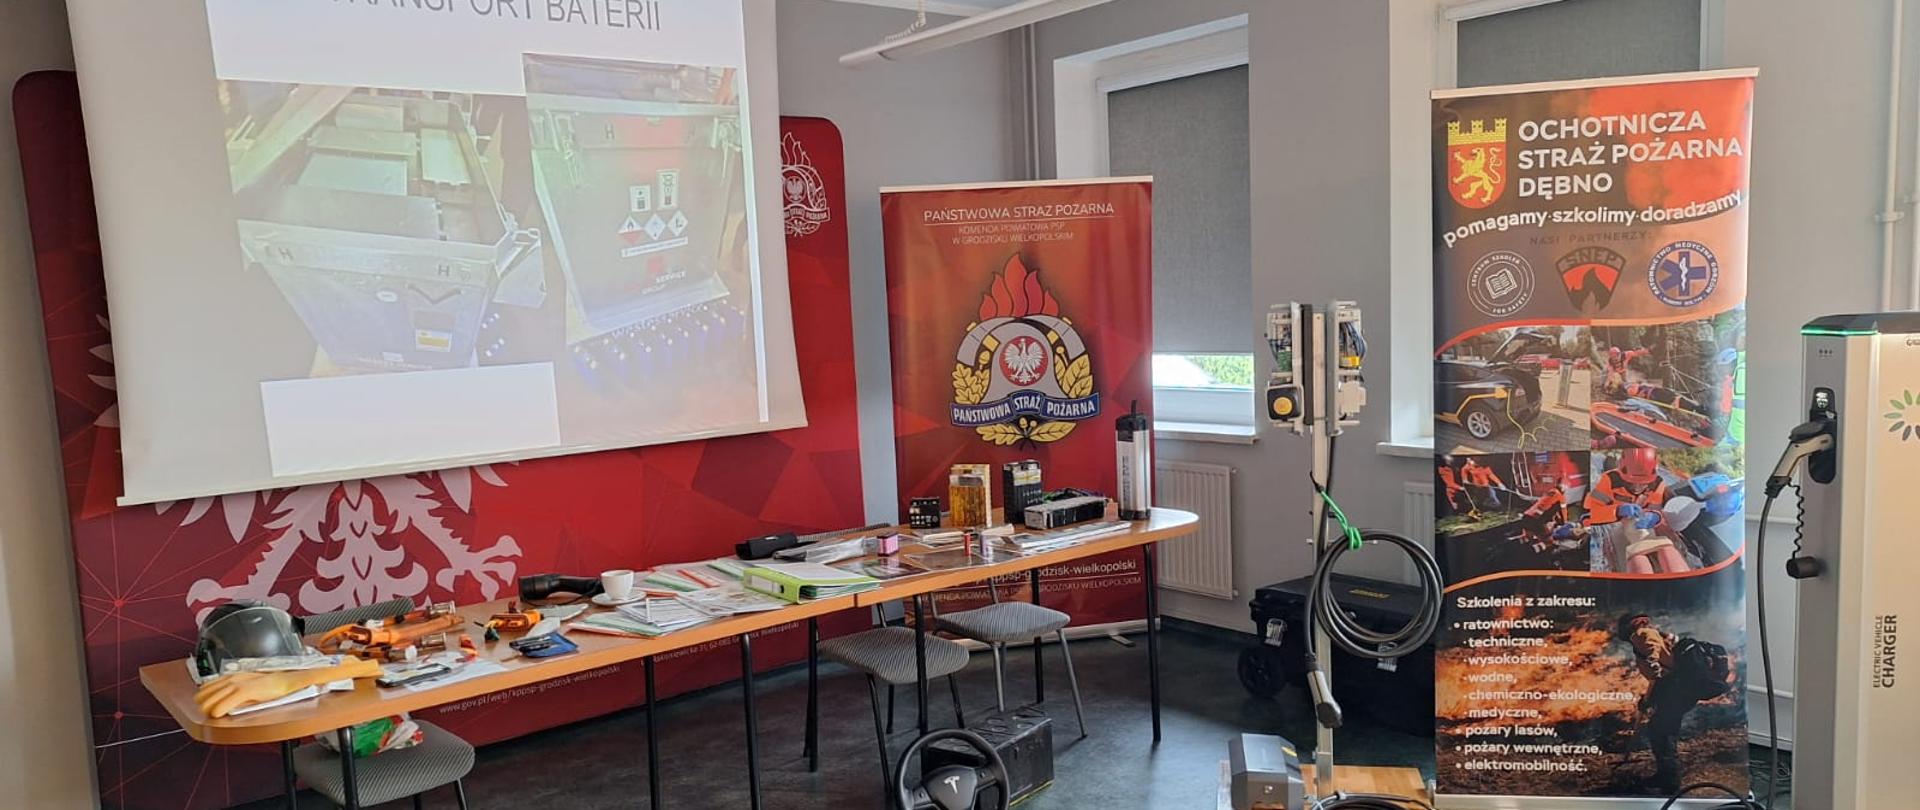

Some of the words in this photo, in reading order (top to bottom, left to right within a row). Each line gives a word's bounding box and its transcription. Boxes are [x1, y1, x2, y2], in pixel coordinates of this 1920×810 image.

[1518, 110, 1707, 142] OCHOTNICZA
[1518, 142, 1605, 170] STRAŻ
[1611, 137, 1743, 164] POŻARNA
[1518, 173, 1612, 200] DĘBNO
[924, 205, 1010, 222] PAŃSTWOWA
[959, 224, 1000, 234] KOMENDA
[953, 402, 1011, 423] PAŃSTWOWA
[1014, 394, 1041, 410] STRAŻ
[1046, 399, 1096, 416] POŻARNA
[1457, 596, 1522, 608] Szkolenia
[1525, 598, 1534, 607] z
[1537, 595, 1596, 607] zakresu:
[1463, 618, 1554, 629] ratownictwo:
[1874, 615, 1883, 649] VEHICLE
[1468, 636, 1548, 648] techniczne,
[1881, 614, 1897, 688] CHARGER
[1468, 653, 1573, 668] wysokościowe,
[1872, 651, 1881, 688] ELECTRIC
[1468, 673, 1517, 684] wodne,
[1468, 689, 1637, 703] chemiczno-ekologiczne,
[1468, 708, 1542, 720] medyczne,
[1465, 725, 1511, 738] pożary
[1515, 725, 1558, 737] lasów,
[1464, 742, 1510, 755] pożary
[1513, 742, 1603, 756] wewnętrzne,
[1464, 759, 1588, 772] elektromobilność.
